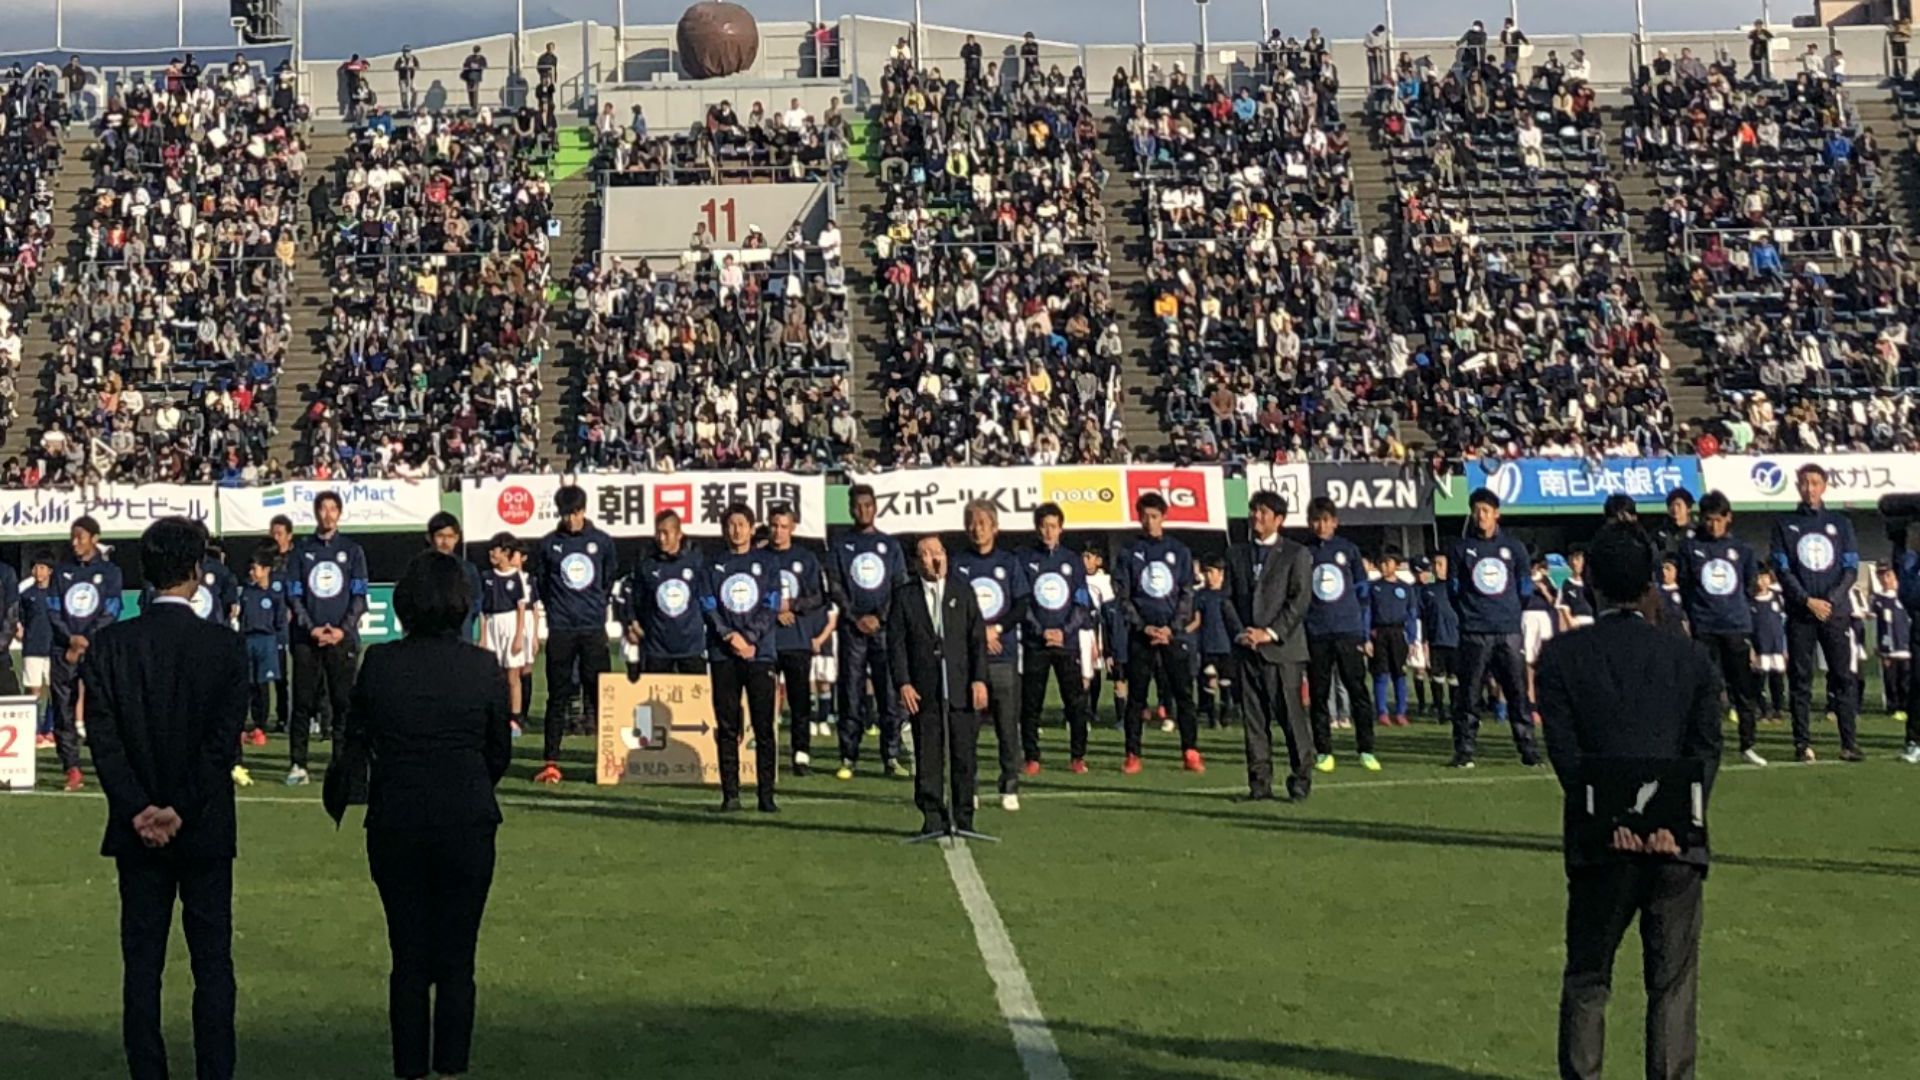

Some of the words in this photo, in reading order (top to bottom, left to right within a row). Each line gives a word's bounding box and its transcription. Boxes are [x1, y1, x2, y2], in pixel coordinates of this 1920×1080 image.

[701, 197, 736, 242] 11
[1537, 466, 1683, 497] 南日本銀行
[1, 497, 70, 526] Asahi
[596, 481, 801, 526] 朝日新聞
[875, 482, 1038, 518] スポーツくじ
